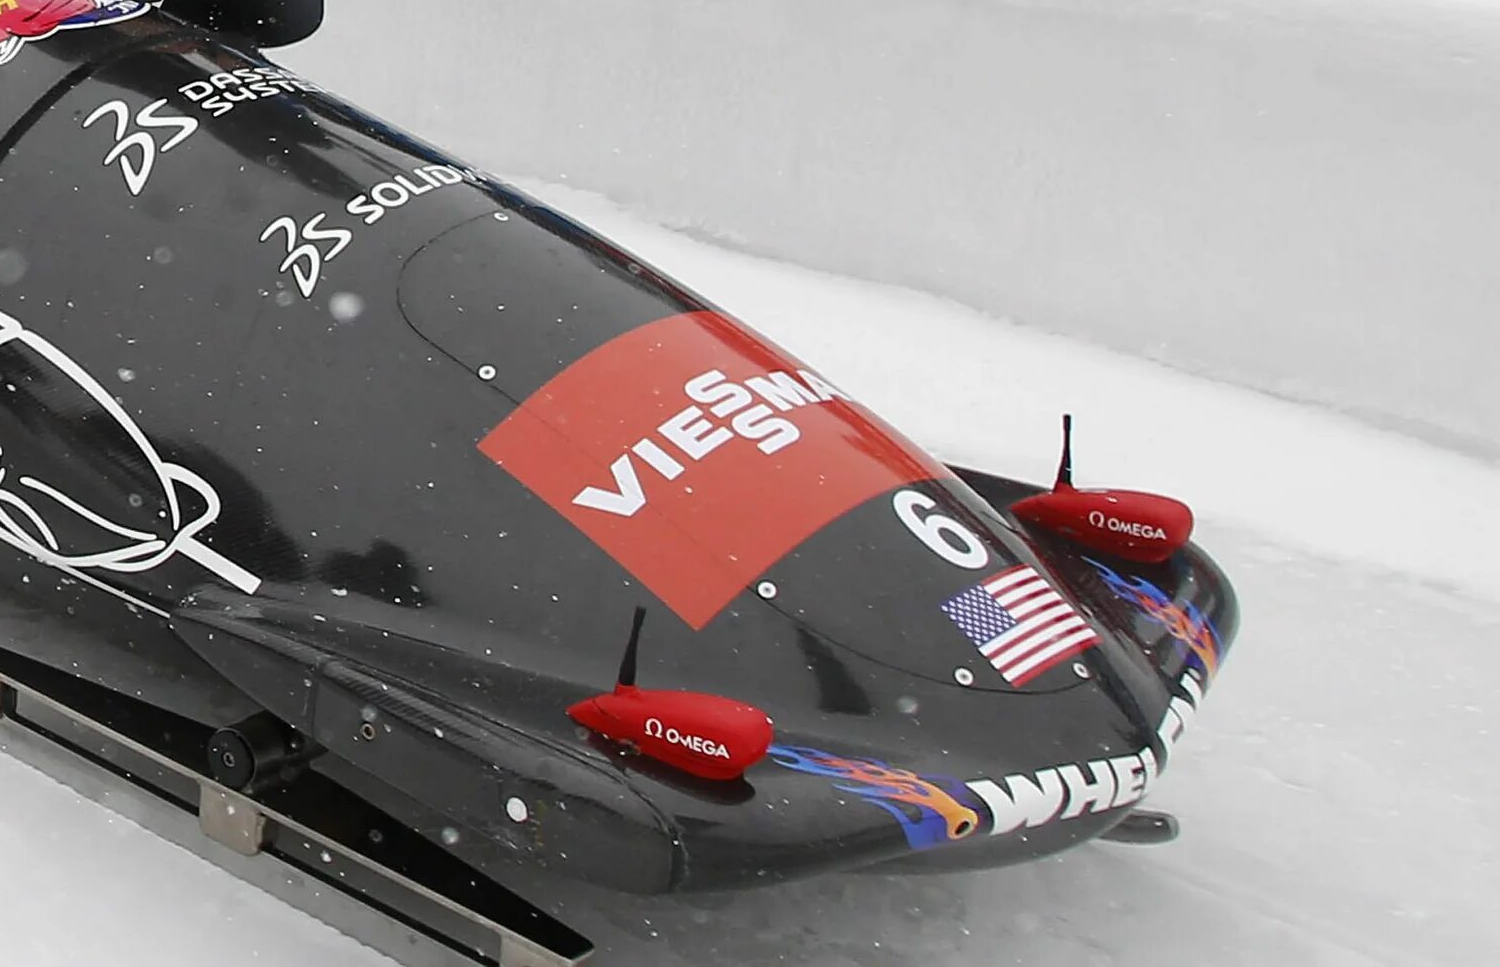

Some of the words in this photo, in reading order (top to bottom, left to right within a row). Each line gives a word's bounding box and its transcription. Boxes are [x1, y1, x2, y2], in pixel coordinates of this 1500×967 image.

[892, 489, 990, 570] 6
[1107, 517, 1168, 541] OMEGA
[665, 727, 731, 760] OMEGA
